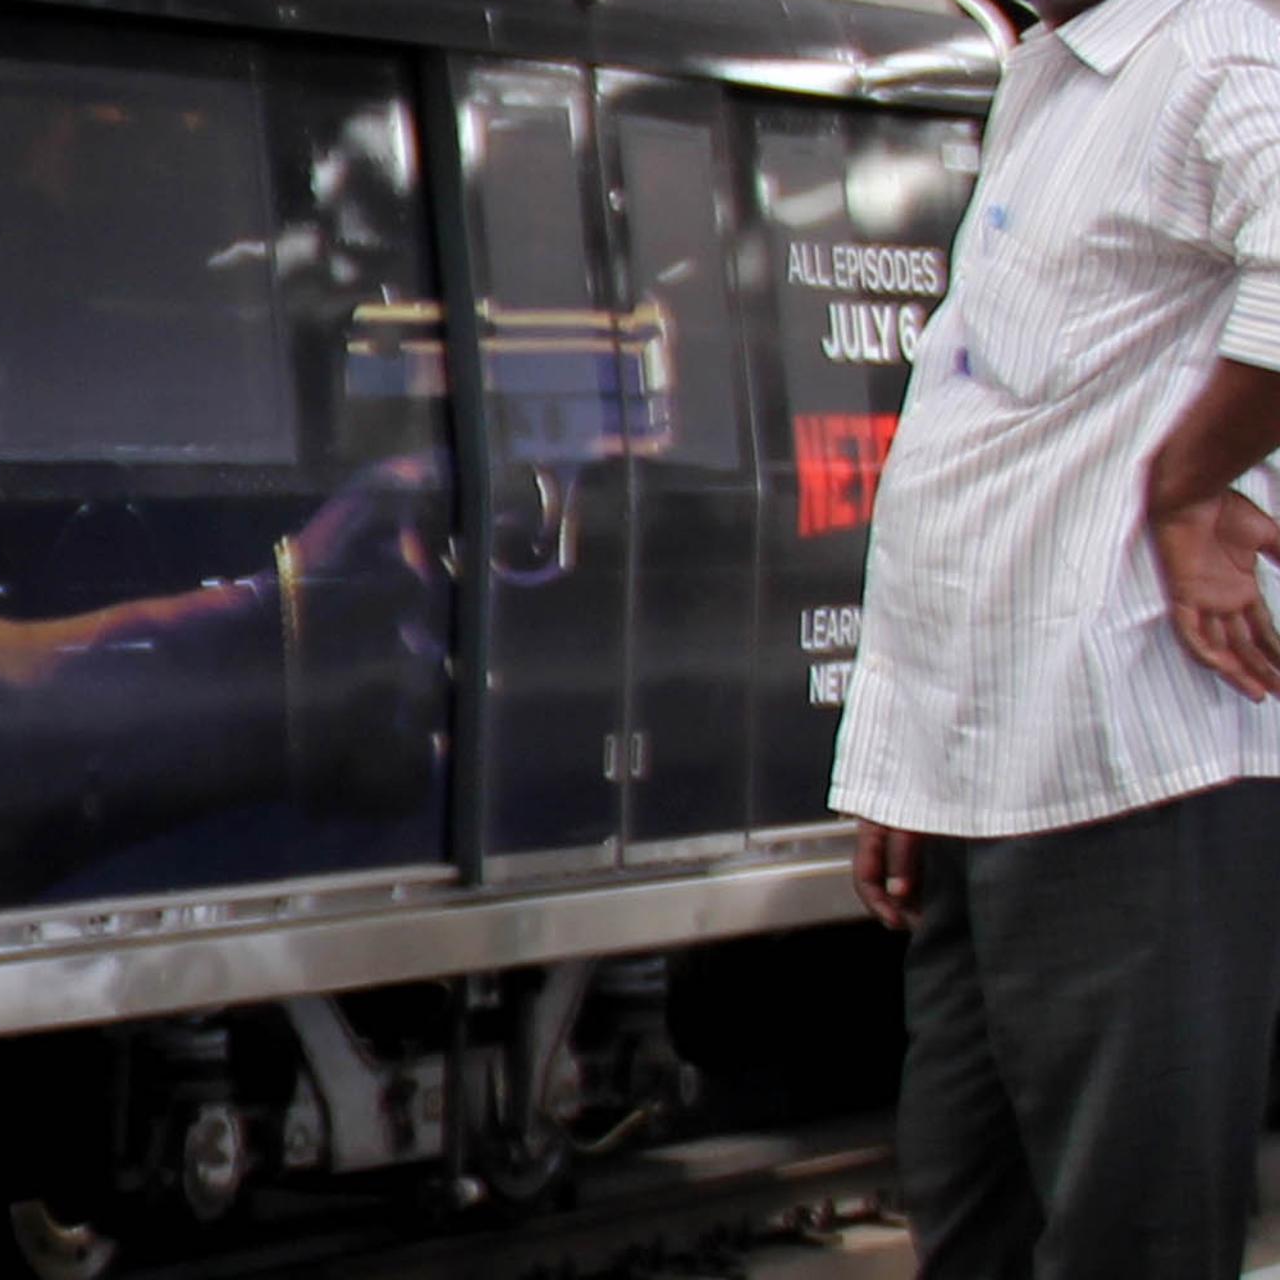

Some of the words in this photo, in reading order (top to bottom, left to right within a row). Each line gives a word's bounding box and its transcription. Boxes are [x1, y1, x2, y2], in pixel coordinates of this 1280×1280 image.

[788, 242, 831, 287] ALL
[832, 245, 939, 294] EPISODES
[821, 303, 891, 361] JULY
[898, 305, 918, 362] 6
